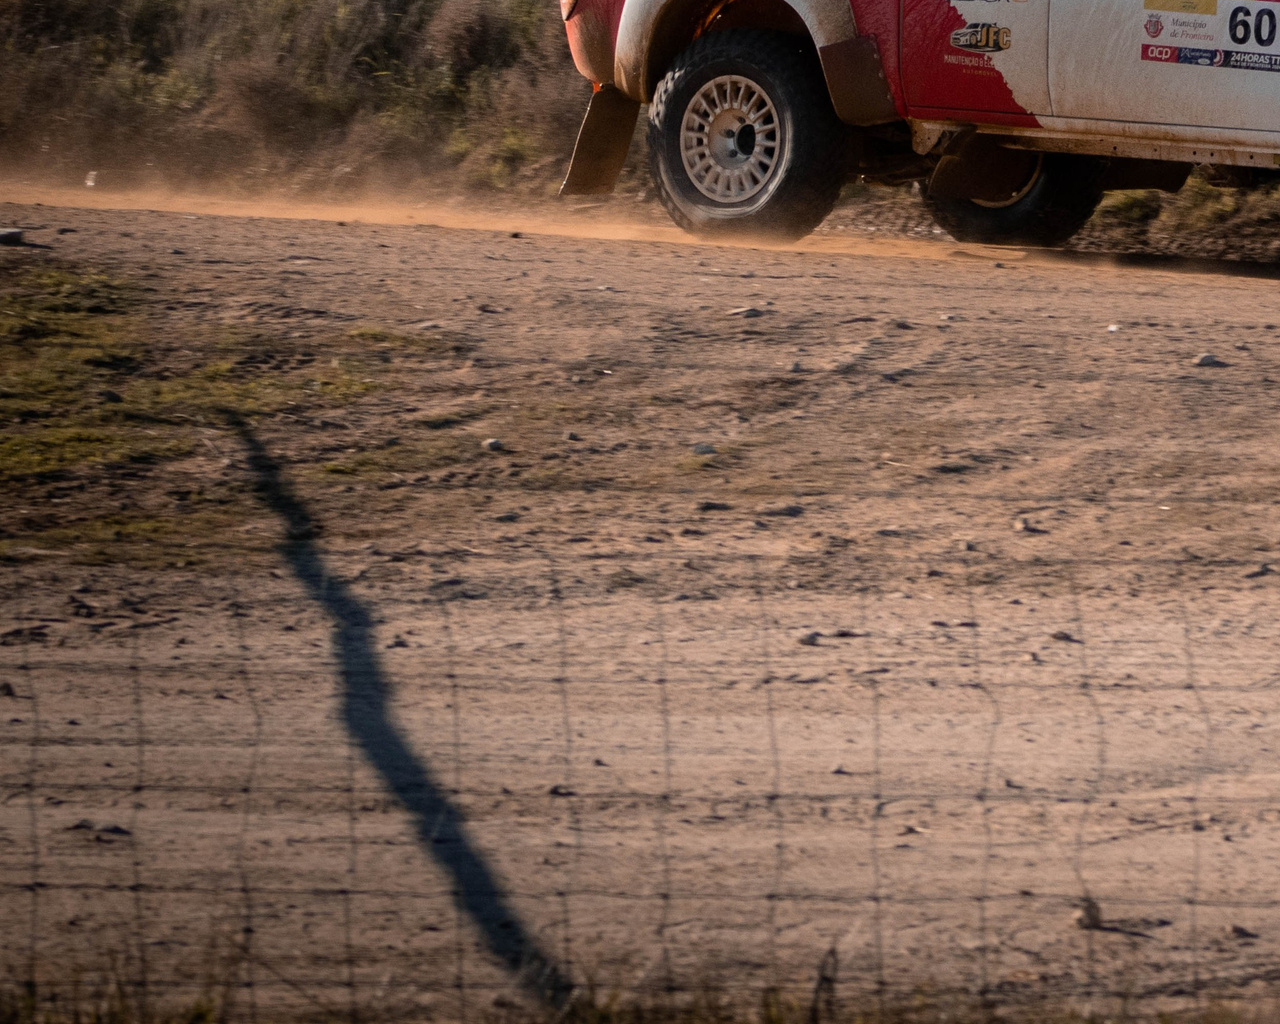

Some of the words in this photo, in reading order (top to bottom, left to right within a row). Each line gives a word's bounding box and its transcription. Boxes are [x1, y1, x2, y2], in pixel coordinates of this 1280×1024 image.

[1170, 29, 1179, 38] de
[1229, 6, 1277, 47] 60
[977, 26, 1011, 49] JFC
[1148, 47, 1171, 60] acp
